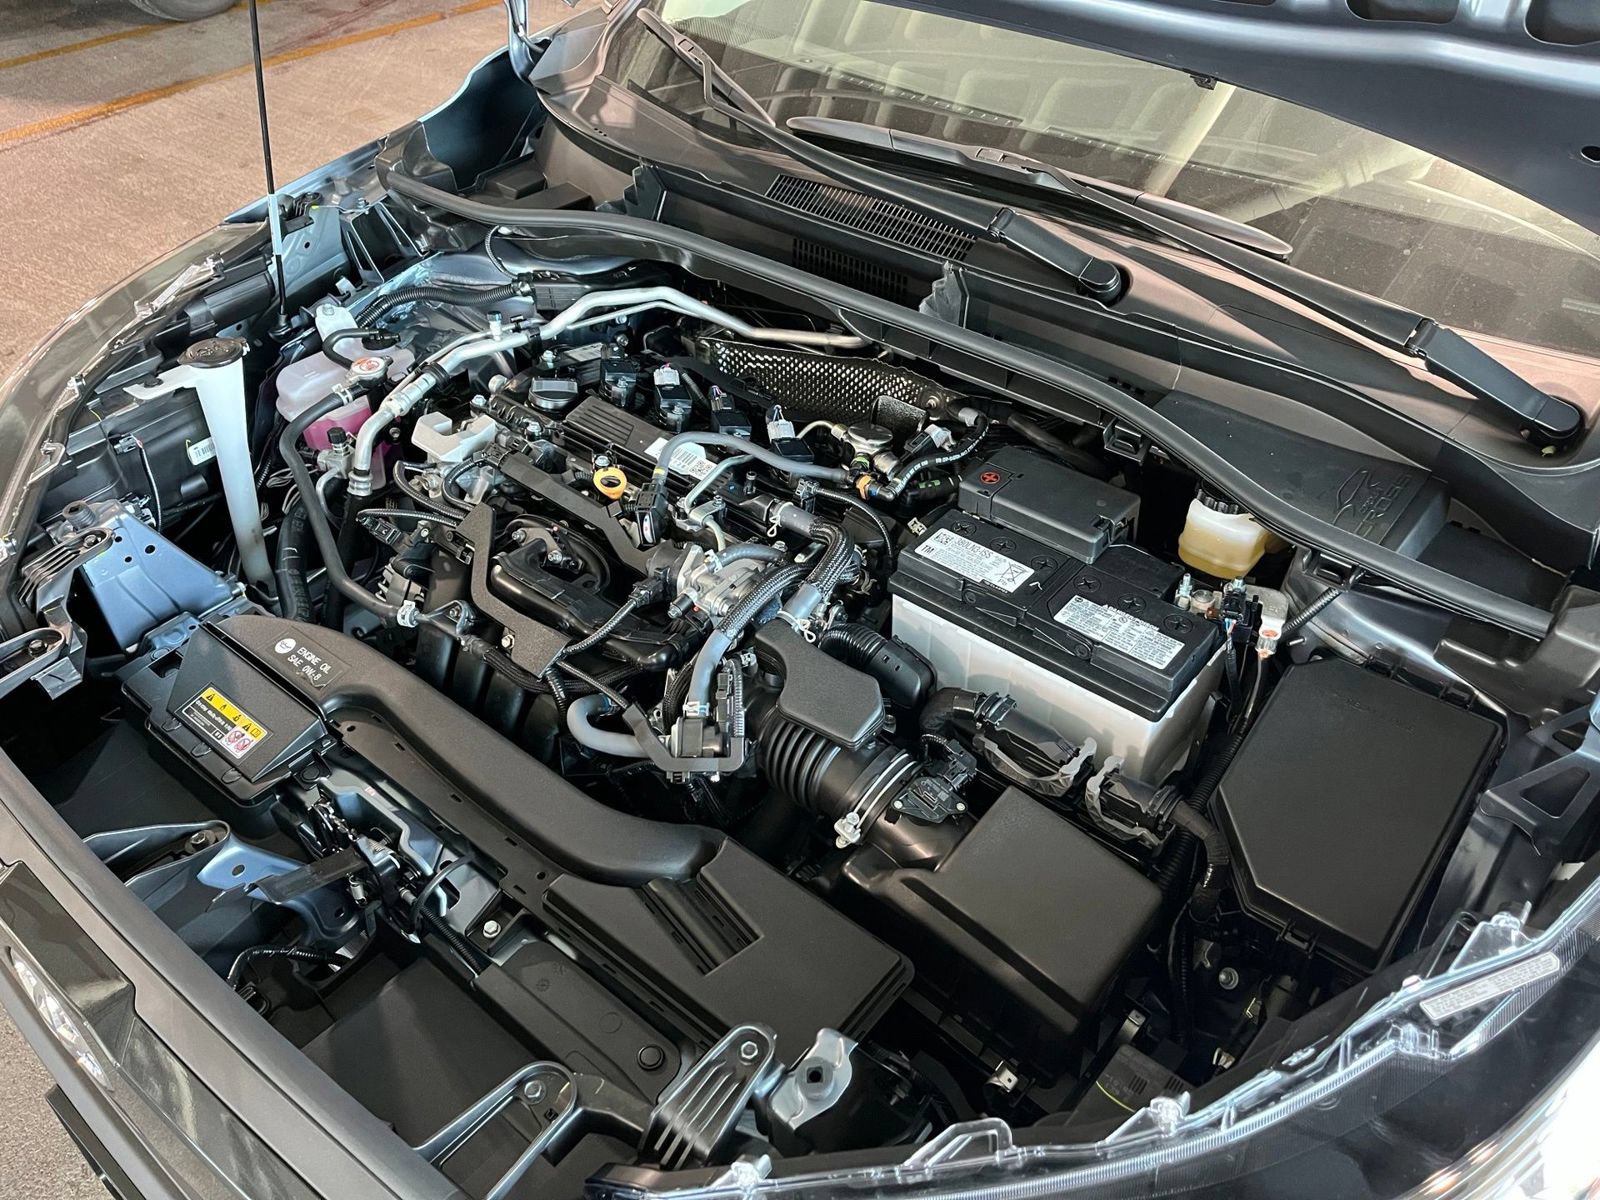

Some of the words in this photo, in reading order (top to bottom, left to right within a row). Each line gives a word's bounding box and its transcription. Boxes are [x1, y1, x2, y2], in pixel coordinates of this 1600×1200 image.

[920, 545, 934, 555] TM
[287, 655, 303, 667] SAE
[297, 647, 321, 665] ENGINE
[320, 663, 332, 674] OIL
